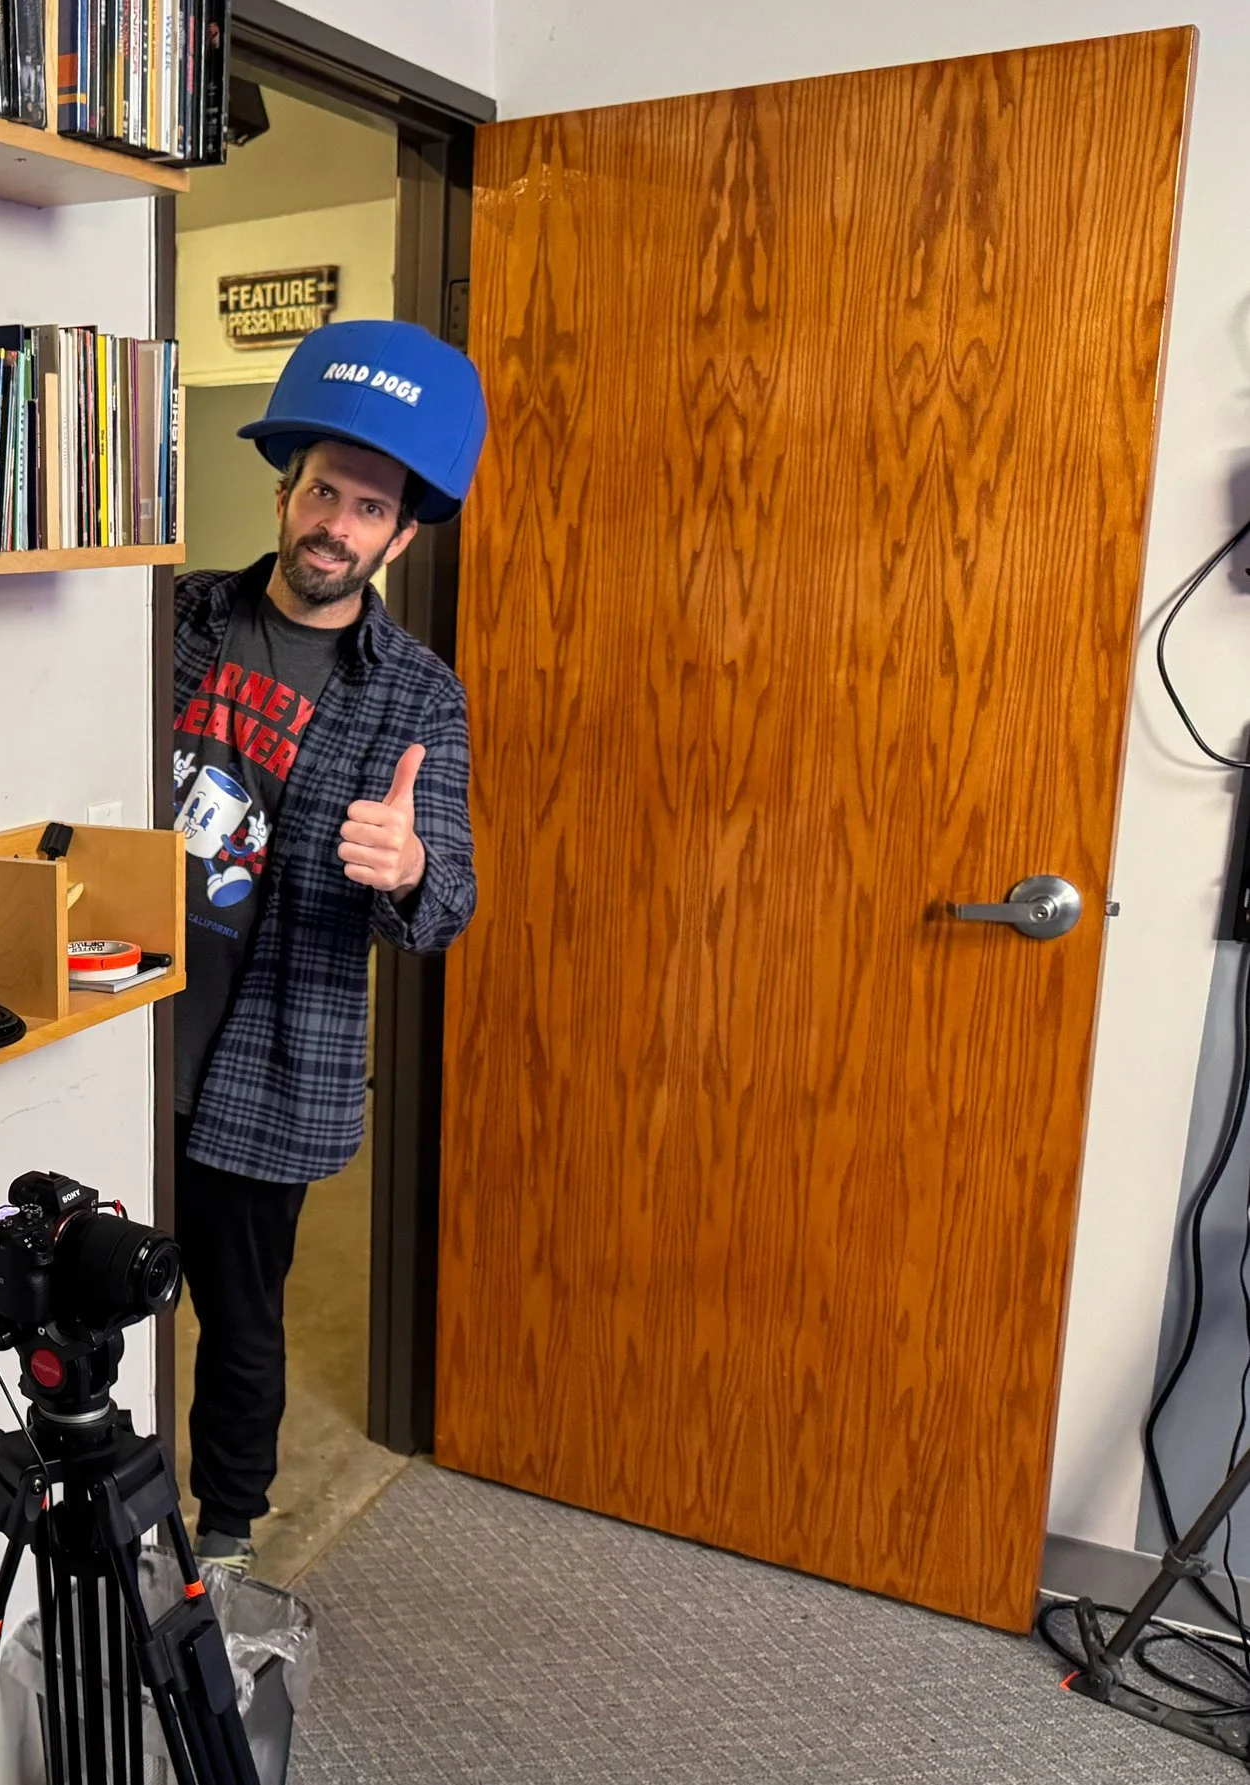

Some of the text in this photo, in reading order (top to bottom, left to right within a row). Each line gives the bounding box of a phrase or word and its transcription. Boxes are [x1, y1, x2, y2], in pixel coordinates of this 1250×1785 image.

[228, 278, 317, 311] FEATURE
[228, 305, 320, 337] PRESENTATION
[323, 362, 423, 403] ROAD DOGS
[197, 662, 315, 736] ARNEY
[174, 699, 299, 782] EAVER
[188, 912, 240, 940] CALIFORNIA
[61, 1189, 81, 1204] SONY
